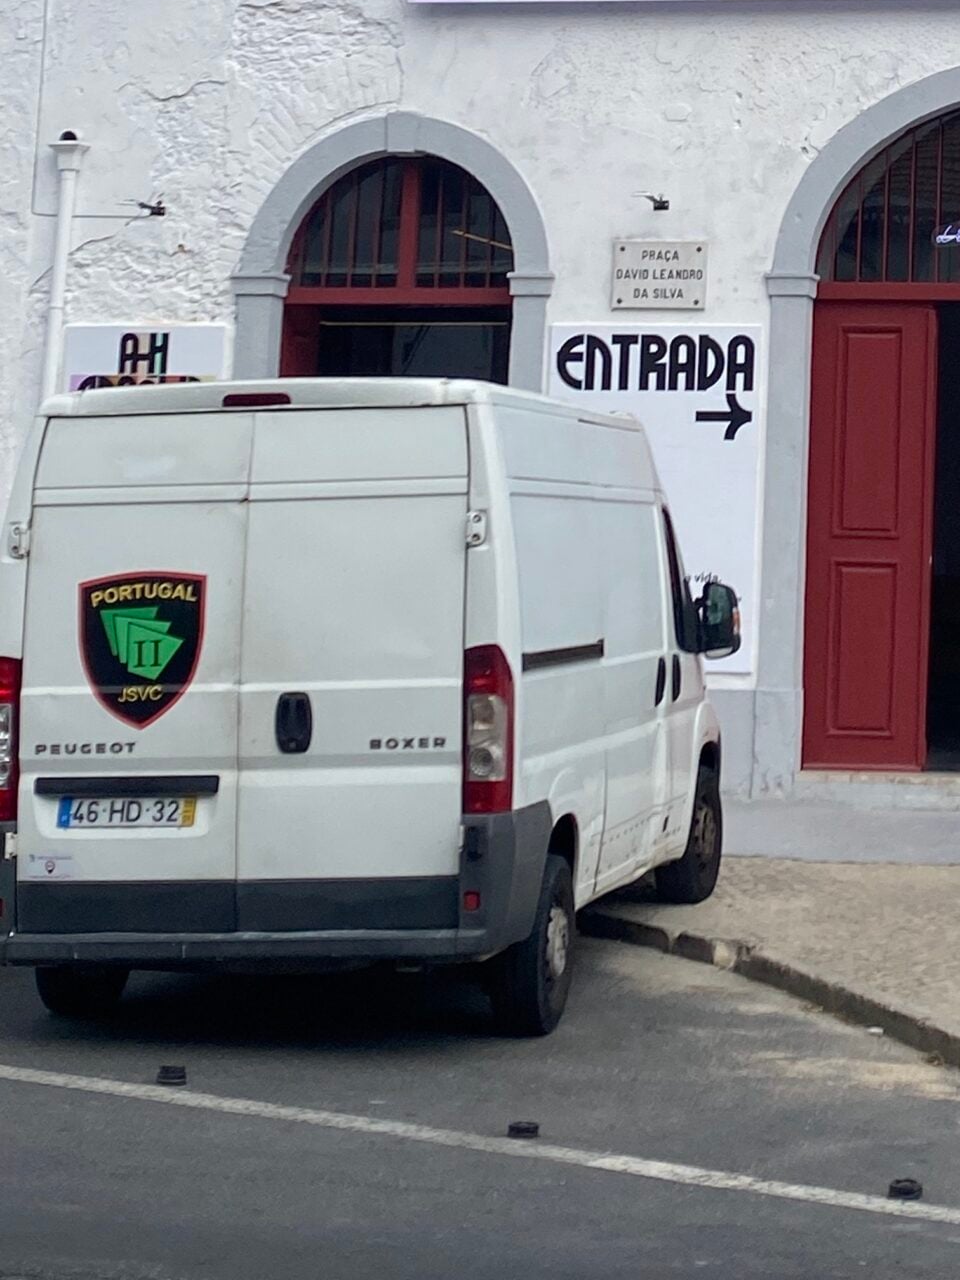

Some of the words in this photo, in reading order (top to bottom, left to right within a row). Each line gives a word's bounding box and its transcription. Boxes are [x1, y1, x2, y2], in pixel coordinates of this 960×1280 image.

[641, 250, 680, 262] PRAÇA
[616, 269, 649, 280] DAVID
[653, 269, 703, 280] LEANDRO
[633, 288, 648, 299] DA
[653, 288, 684, 299] SILVA
[119, 332, 169, 374] AH
[556, 334, 755, 391] ENTRADA
[90, 582, 198, 608] PORTUGAL
[117, 684, 163, 702] JSVC
[35, 742, 136, 755] PEUGEOT
[369, 737, 446, 750] BOXER
